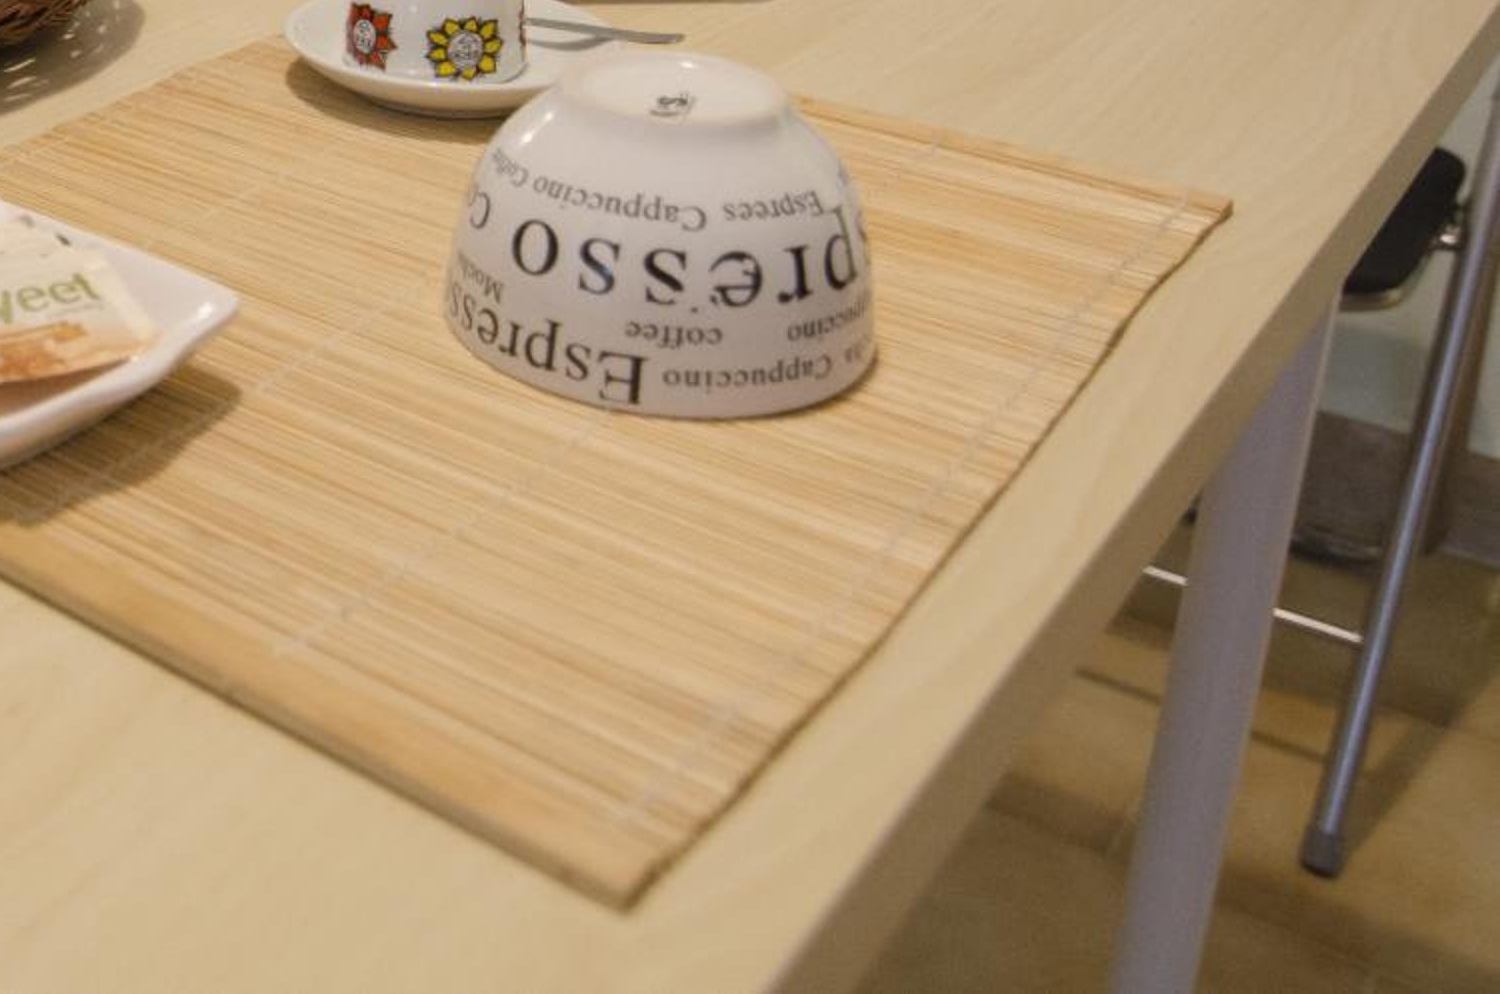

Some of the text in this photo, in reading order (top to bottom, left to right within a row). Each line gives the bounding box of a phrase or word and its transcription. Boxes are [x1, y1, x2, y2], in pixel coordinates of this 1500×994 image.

[534, 175, 708, 234] Cappuccino
[624, 320, 724, 350] coffee
[662, 353, 833, 392] Cappuccino
